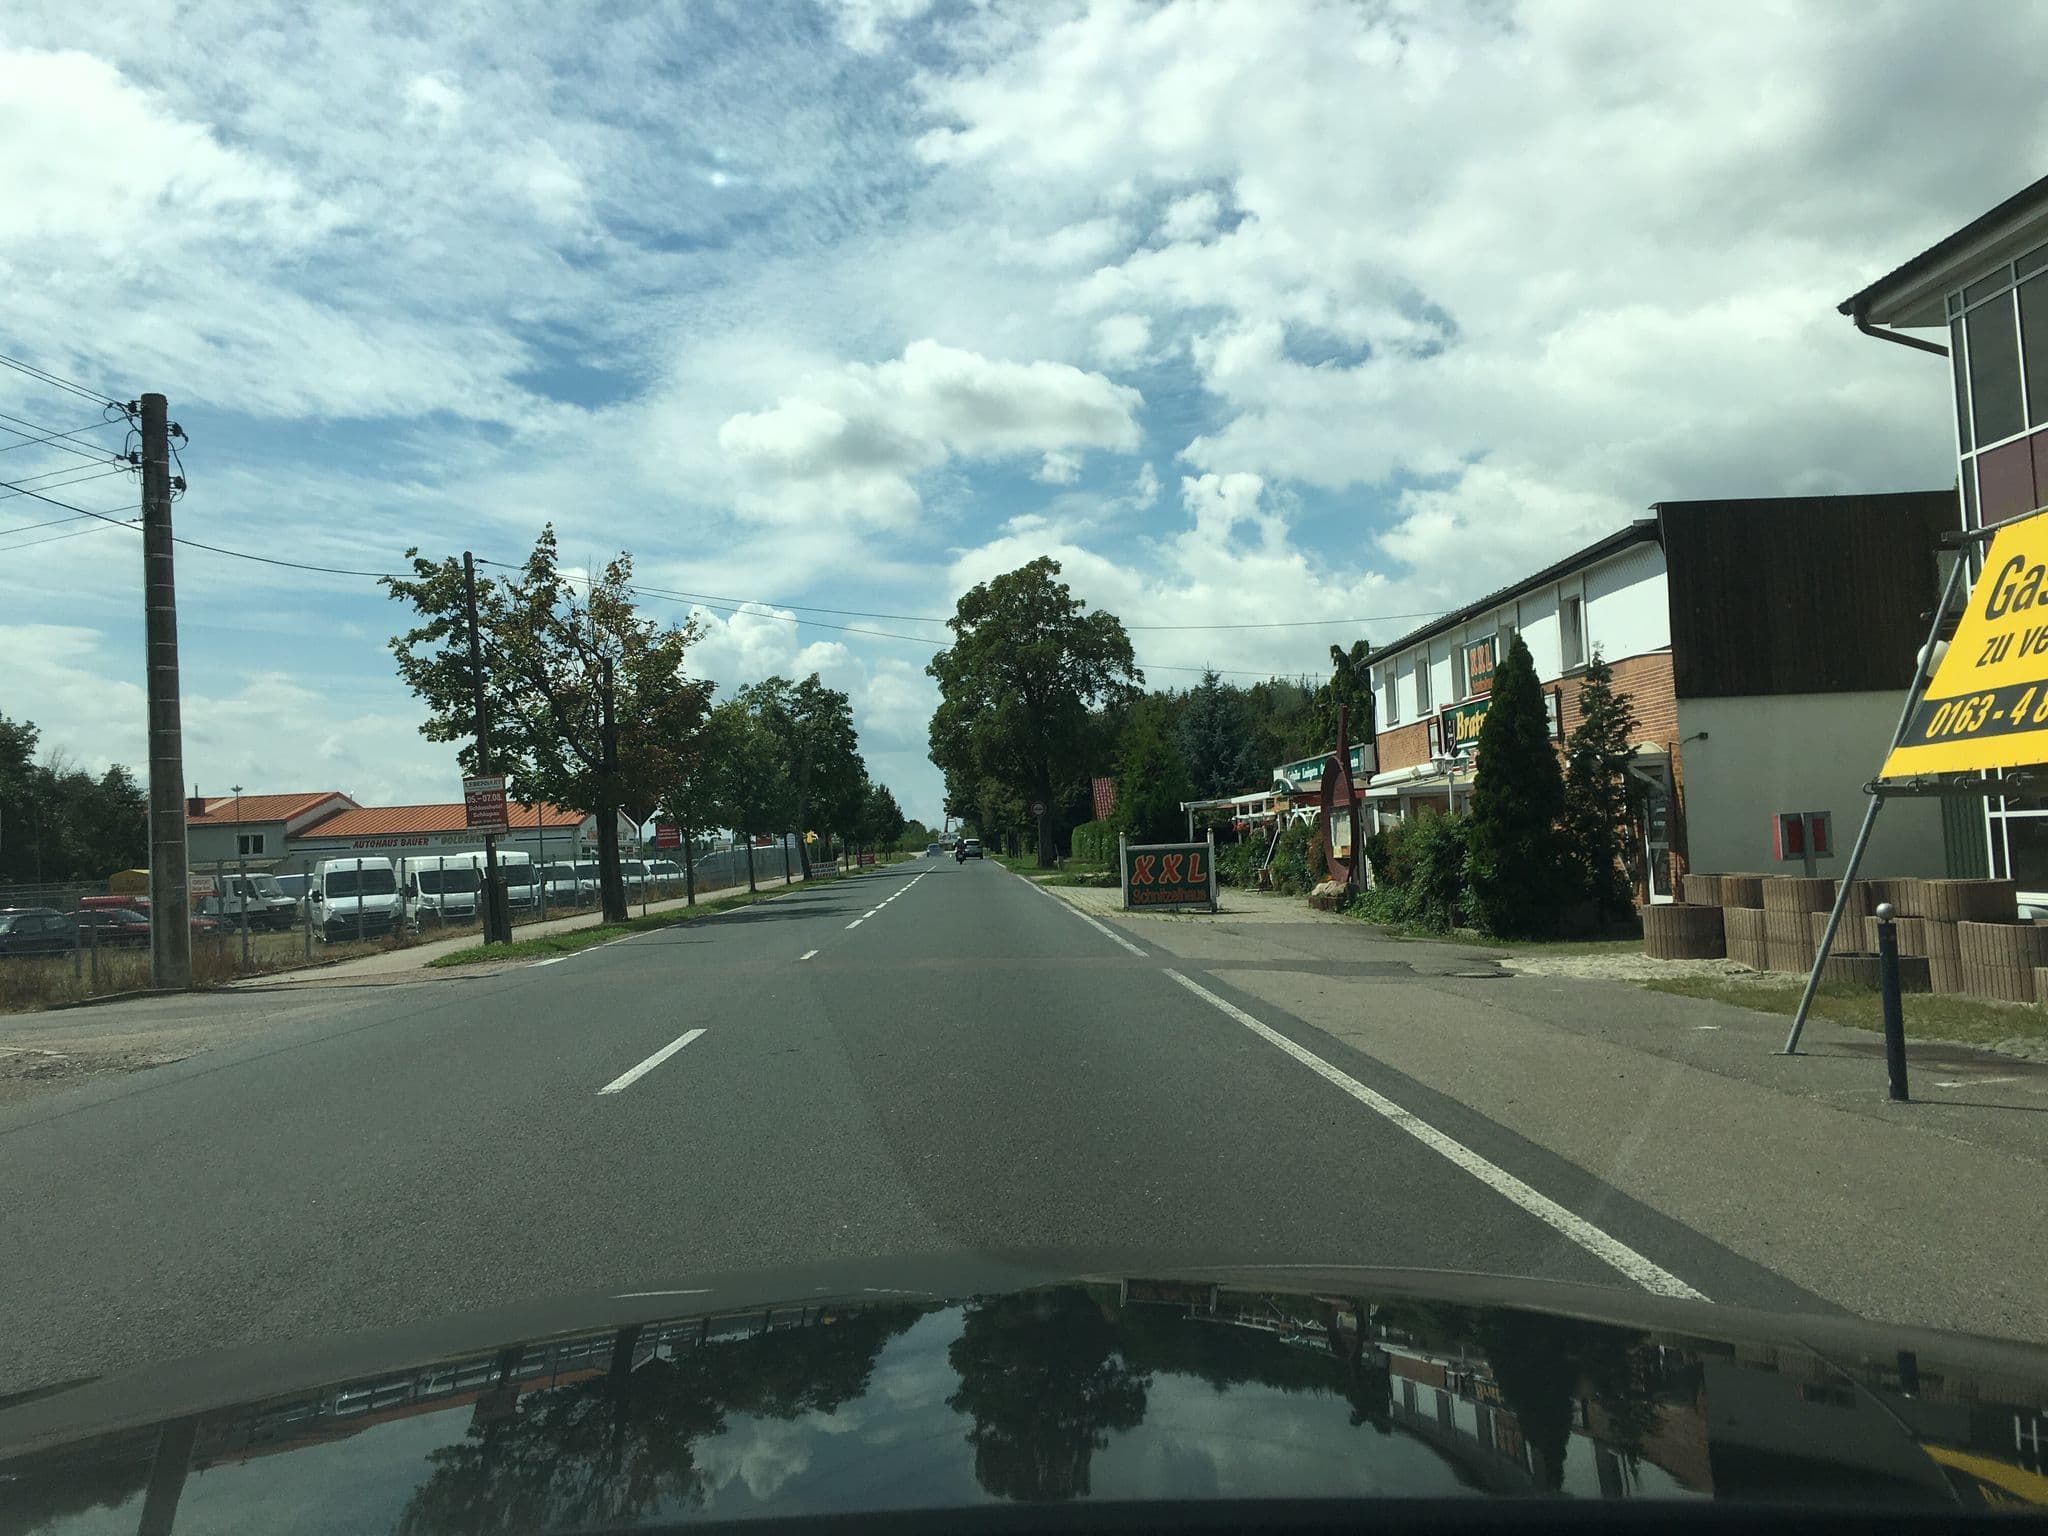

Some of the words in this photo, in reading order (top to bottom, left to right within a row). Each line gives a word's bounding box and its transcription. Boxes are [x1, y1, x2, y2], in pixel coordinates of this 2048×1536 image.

[1470, 643, 1493, 676] XXL
[1975, 633, 2015, 667] zu
[353, 838, 399, 849] AUTOHAUS
[400, 837, 430, 847] BAUER
[1131, 853, 1207, 885] XXL
